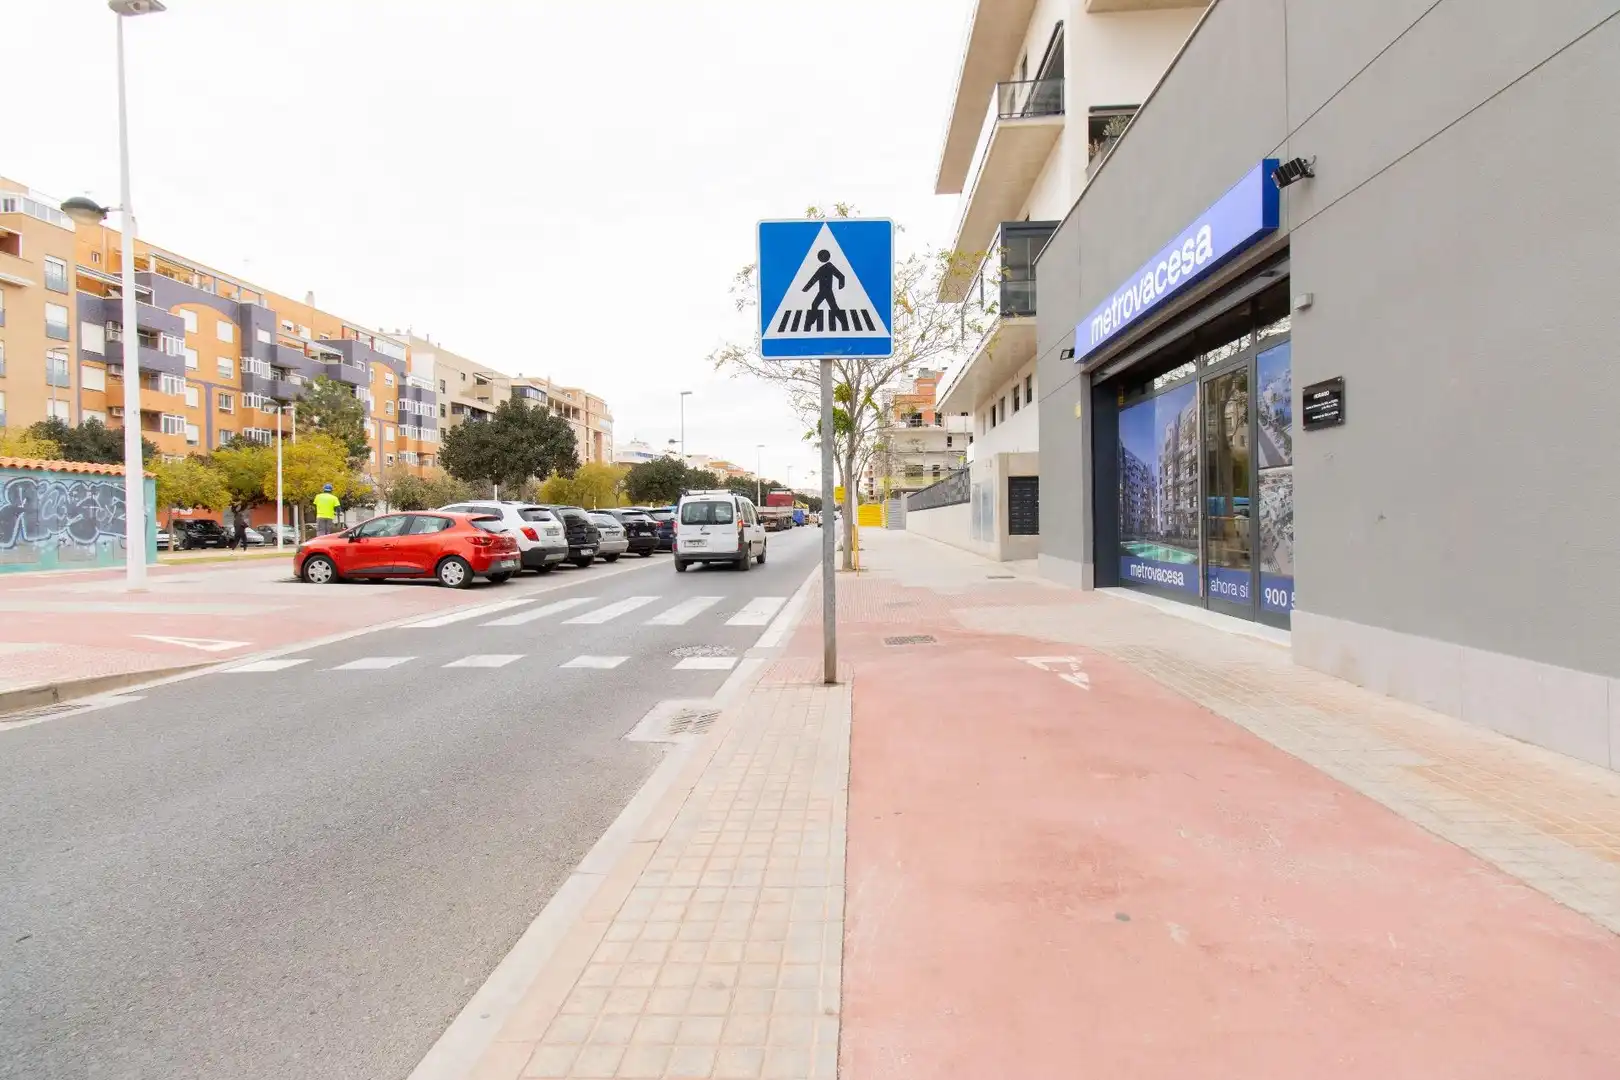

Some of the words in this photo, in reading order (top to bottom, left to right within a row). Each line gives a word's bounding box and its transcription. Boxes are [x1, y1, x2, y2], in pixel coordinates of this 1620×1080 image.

[1091, 224, 1213, 345] metrovacesa
[1130, 562, 1184, 586] metrovacesa
[1210, 578, 1237, 596] ahora
[1265, 588, 1287, 606] 900
